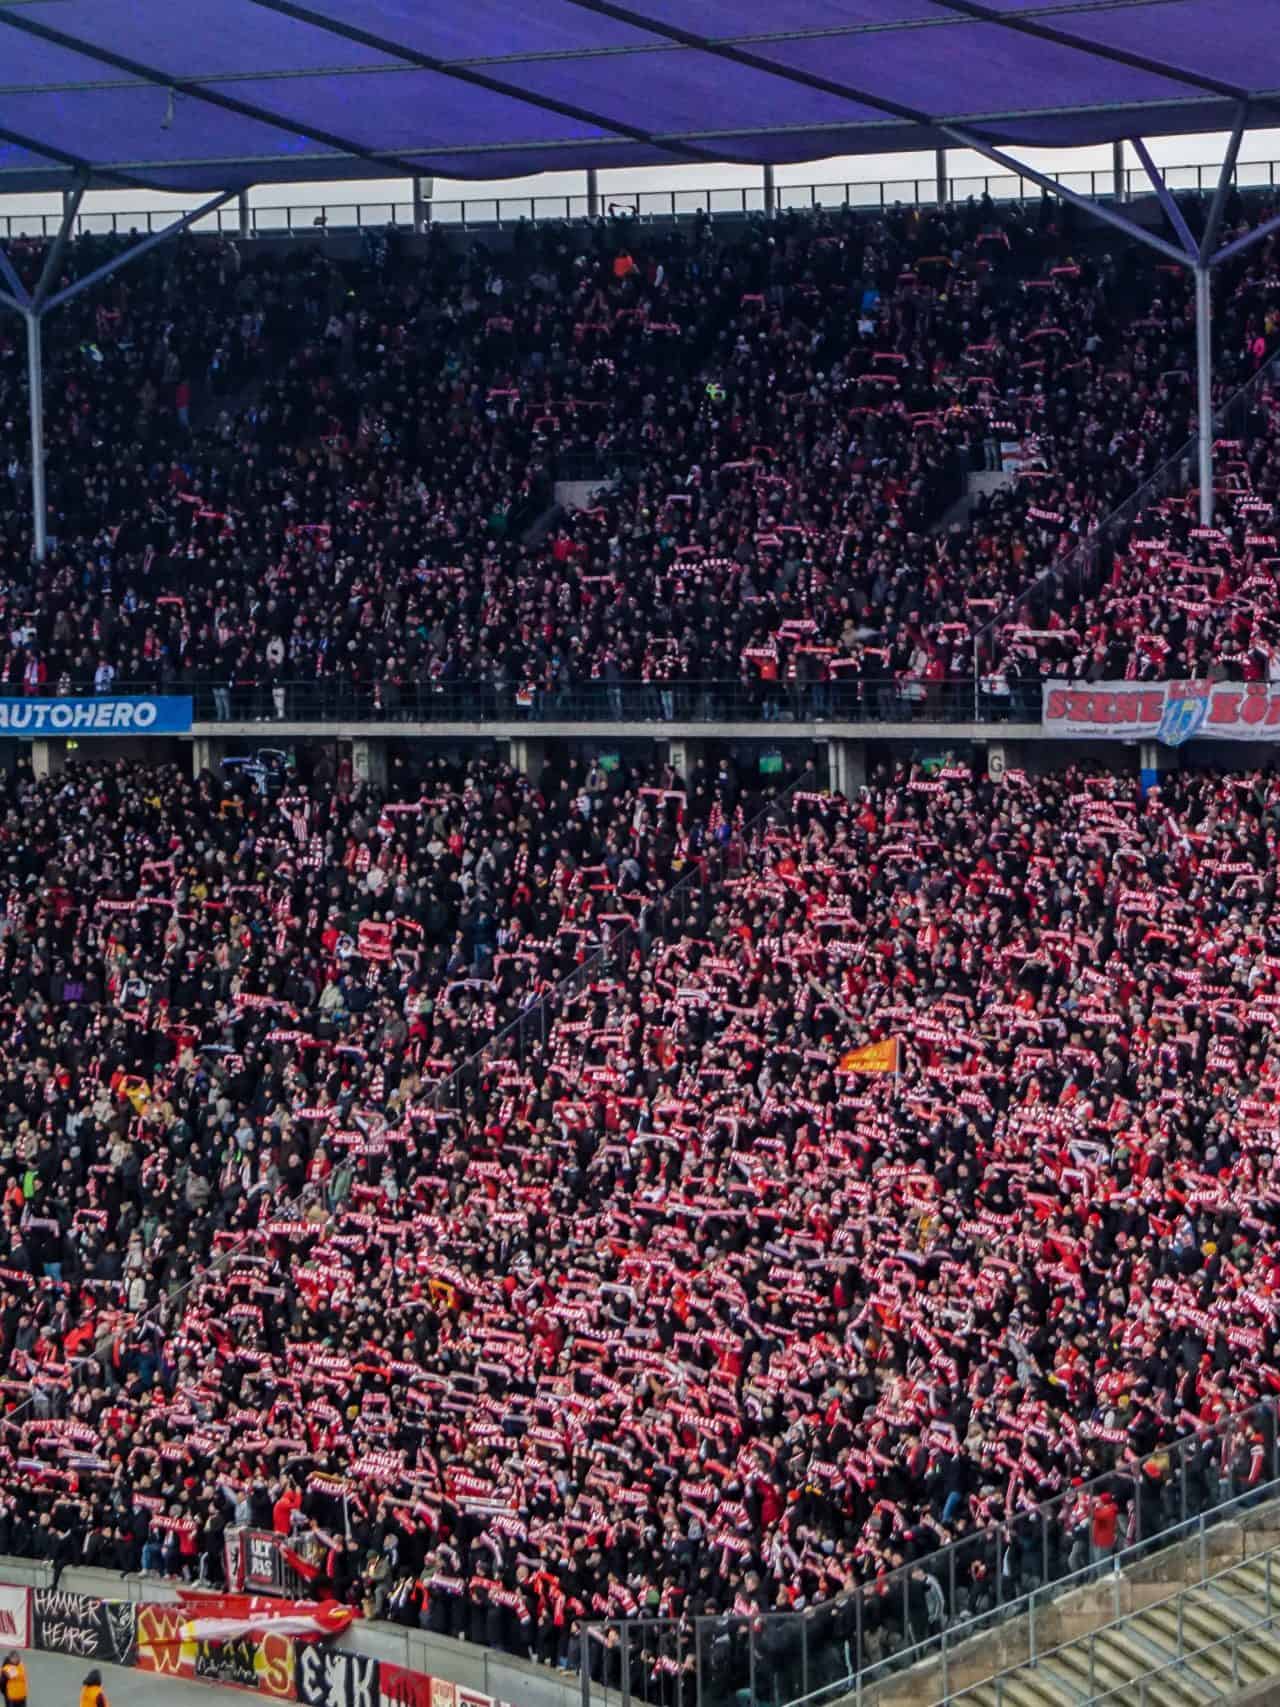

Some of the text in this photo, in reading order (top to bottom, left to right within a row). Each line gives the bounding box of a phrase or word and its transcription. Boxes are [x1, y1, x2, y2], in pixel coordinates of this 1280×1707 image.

[1047, 688, 1163, 725] SZENE
[990, 754, 1003, 772] G
[453, 1474, 492, 1489] UNION
